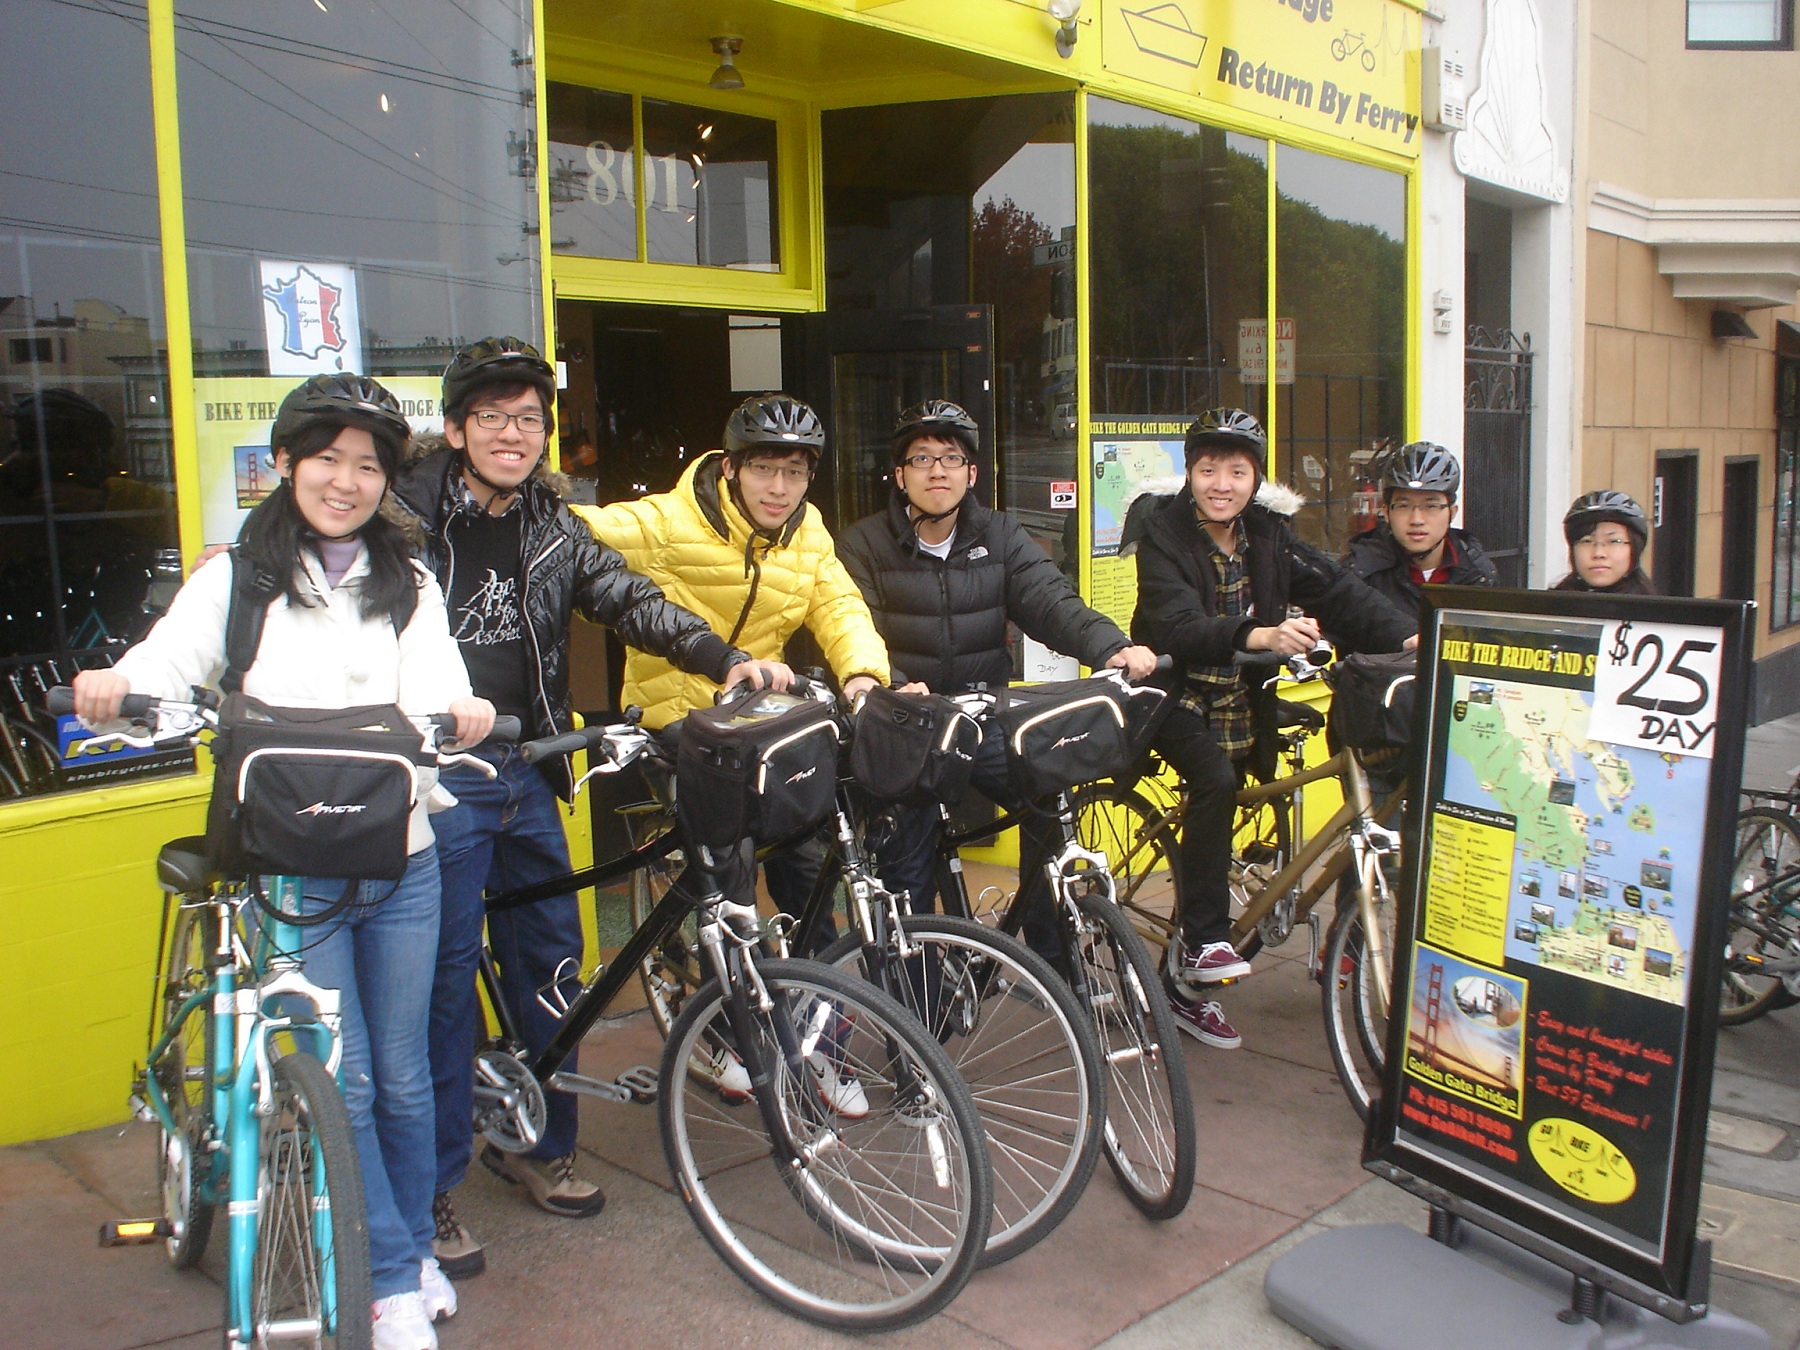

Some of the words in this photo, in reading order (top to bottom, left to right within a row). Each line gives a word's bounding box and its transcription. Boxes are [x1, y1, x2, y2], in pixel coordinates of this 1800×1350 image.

[1217, 47, 1314, 107] Return
[1319, 80, 1351, 125] By
[1355, 93, 1419, 144] Ferry
[586, 140, 679, 213] 801
[205, 403, 243, 421] BIKE
[247, 402, 276, 421] THE
[1105, 422, 1117, 434] THE
[1118, 422, 1140, 434] GOLDEN
[1142, 422, 1157, 434] GATE
[1158, 423, 1180, 434] BRIDGE
[1442, 640, 1471, 662] BIKE
[1472, 643, 1500, 666] THE
[1500, 645, 1552, 672] BRIDGE
[1553, 651, 1583, 676] AND
[1584, 654, 1599, 677] S
[1609, 620, 1718, 716] $25
[1638, 715, 1718, 750] DAY
[1409, 1056, 1443, 1083] Golden
[1445, 1073, 1474, 1095] Gate
[1475, 1084, 1517, 1112] Bridge
[1569, 1136, 1591, 1153] BIKE
